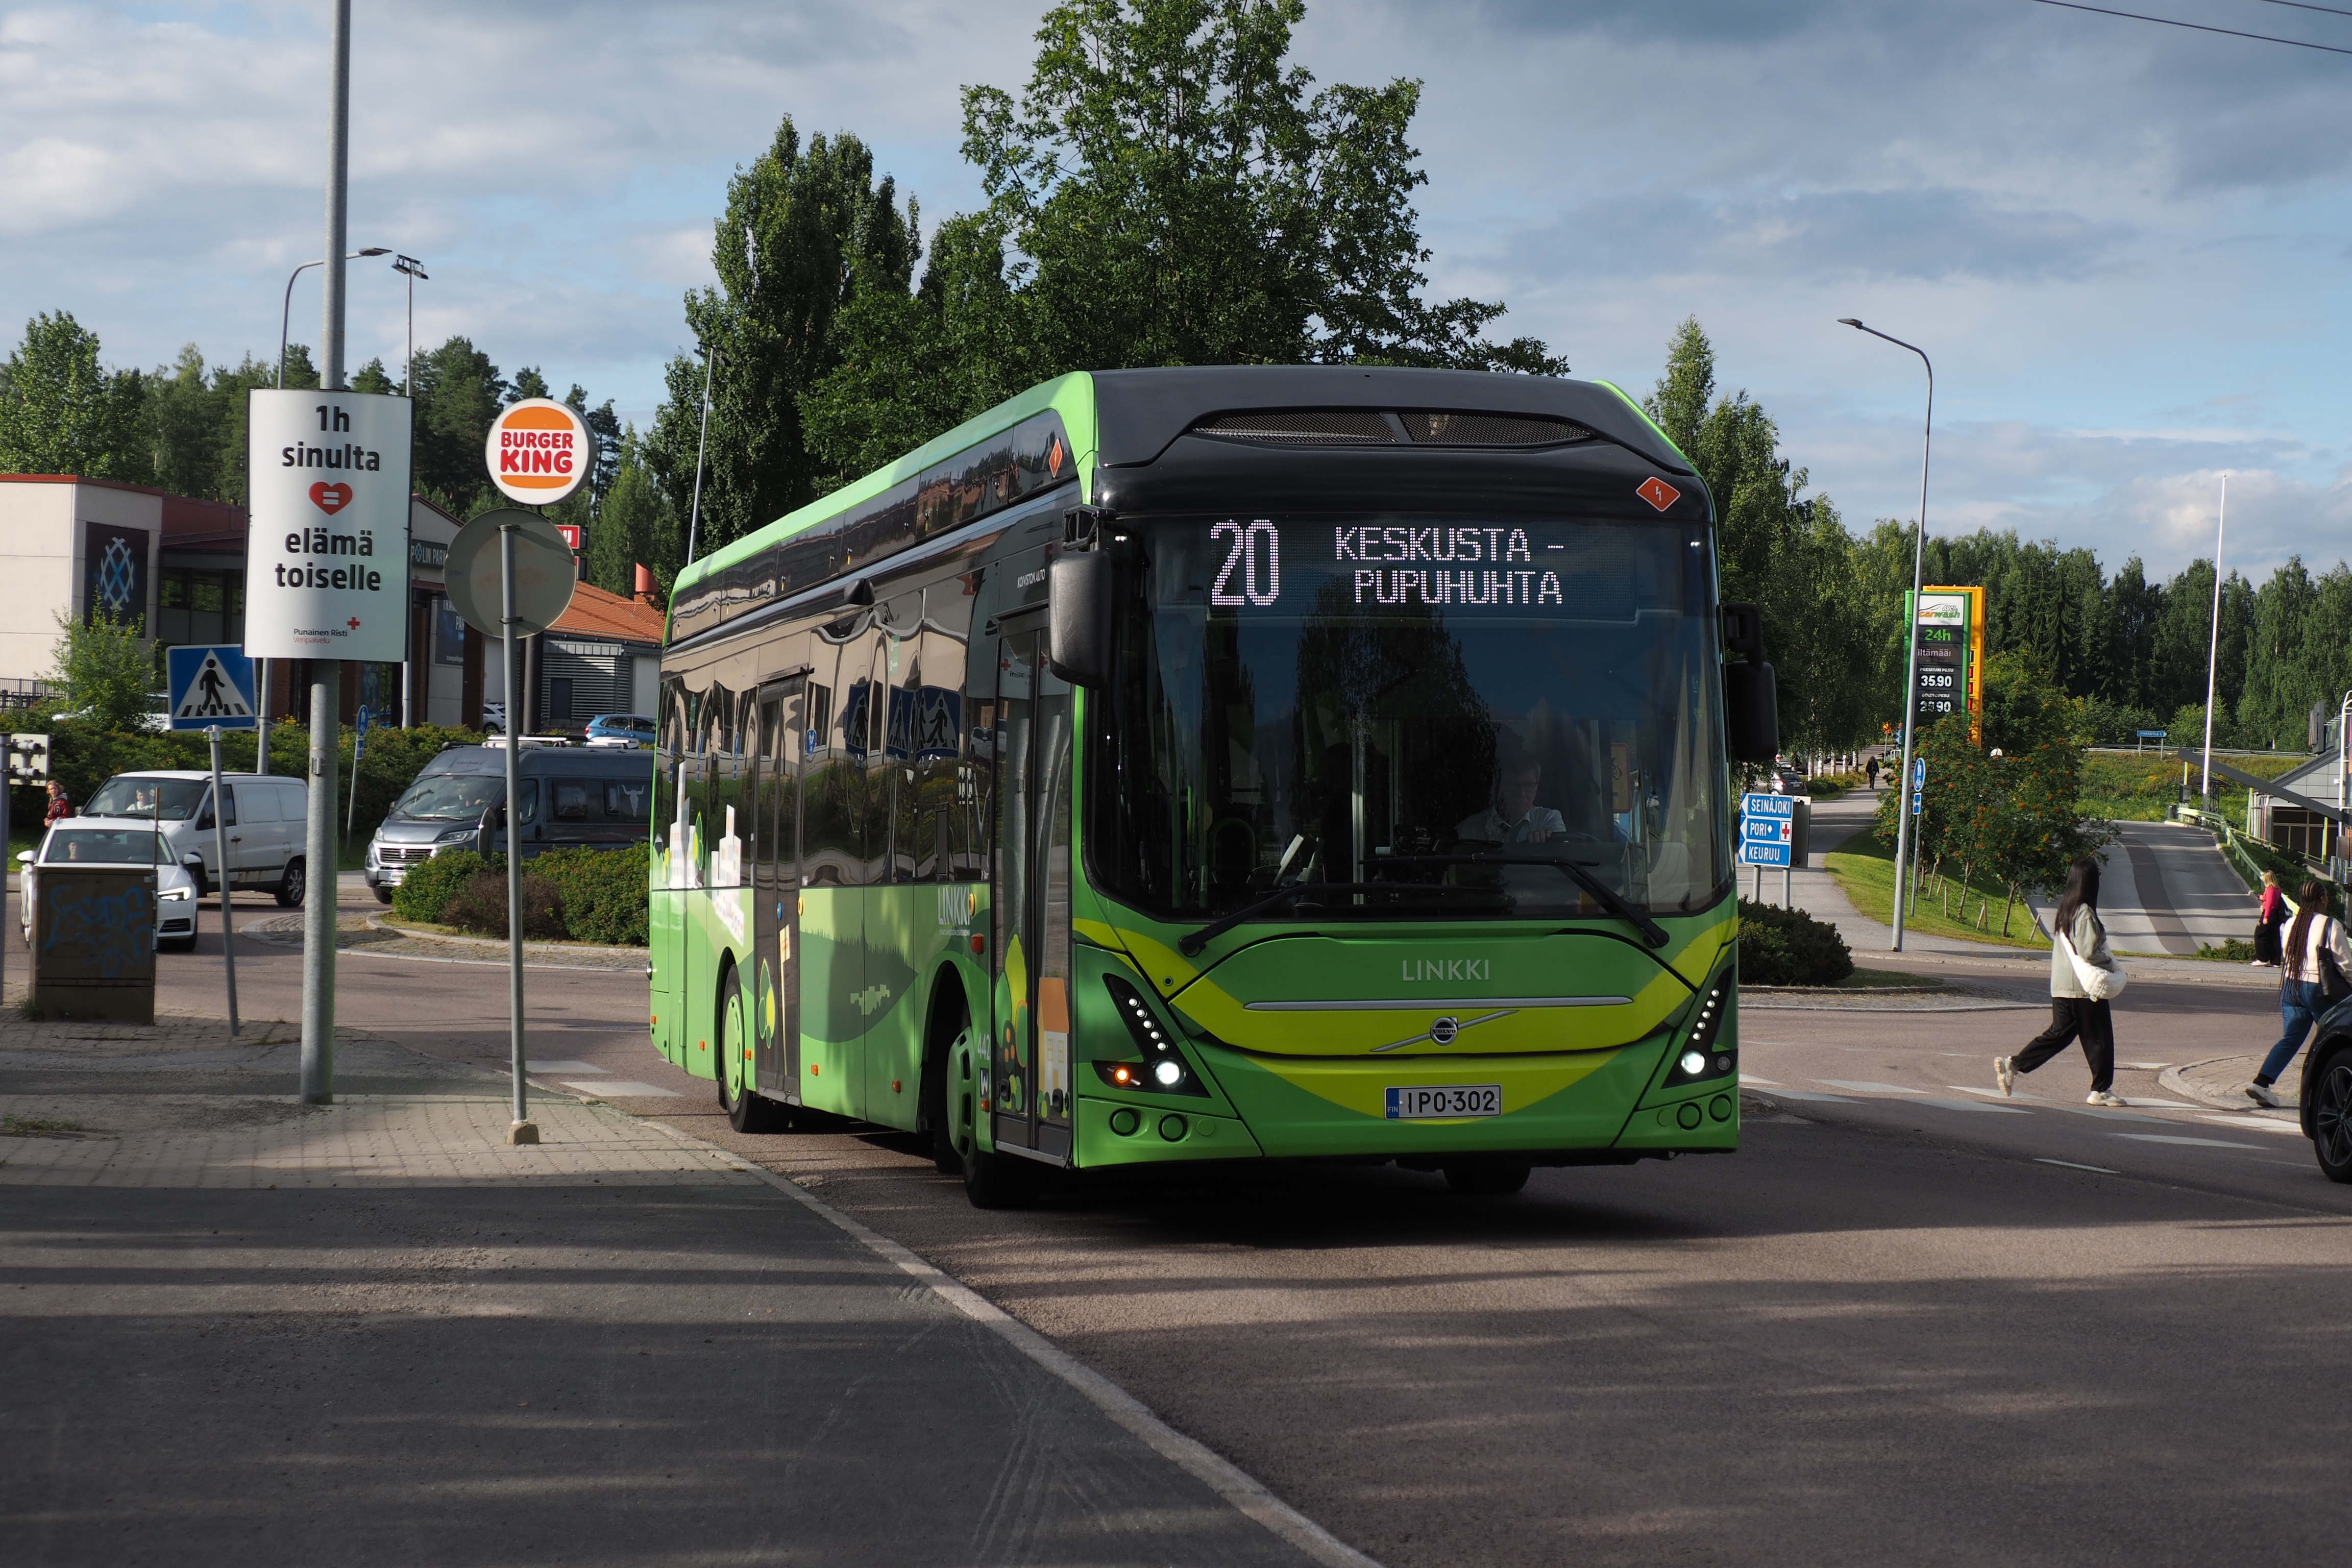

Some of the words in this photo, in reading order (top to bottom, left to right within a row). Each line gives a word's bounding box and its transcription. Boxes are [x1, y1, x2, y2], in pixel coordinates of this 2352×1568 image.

[315, 405, 350, 432] 1h
[501, 431, 574, 449] BURGER
[281, 441, 380, 472] sinulta
[500, 449, 573, 474] KING
[284, 527, 373, 556] elämä
[1210, 519, 1279, 606] 20
[1335, 526, 1530, 561] KESKUSTA
[275, 562, 381, 591] toiselle
[1035, 568, 1046, 583] AUTO
[1354, 569, 1563, 604] PUPUHUHTA
[1919, 608, 1961, 619] carwash
[293, 636, 330, 645] Veripalvelu
[331, 629, 348, 637] Risti
[1924, 628, 1951, 642] 24h
[1920, 675, 1952, 688] 35.90
[1751, 797, 1791, 815] SEINÄJOKI
[1750, 822, 1767, 837] PORI
[1748, 846, 1780, 862] KEURUU
[938, 886, 970, 925] LINKKI
[1403, 959, 1489, 982] LINKKI
[977, 1033, 990, 1061] 442
[1407, 1090, 1495, 1113] IPO-302
